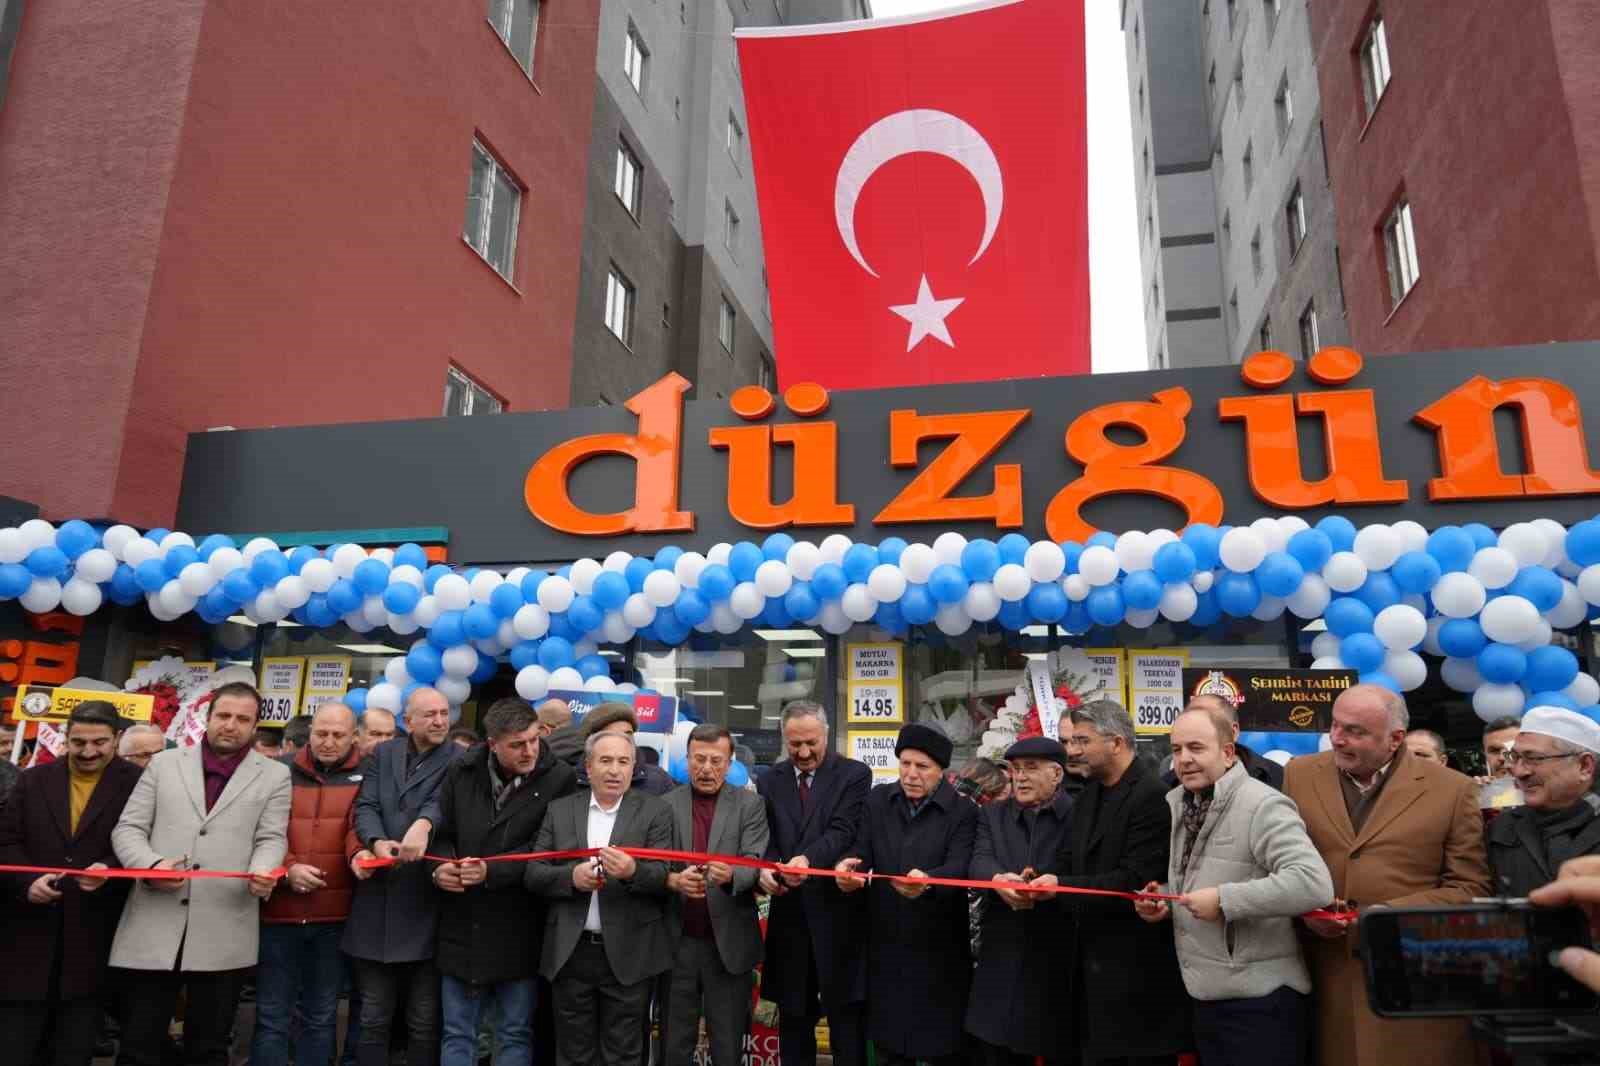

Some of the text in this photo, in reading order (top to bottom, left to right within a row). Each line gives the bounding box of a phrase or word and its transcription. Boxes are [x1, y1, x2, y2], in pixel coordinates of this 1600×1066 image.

[524, 346, 1600, 543] düzgün
[860, 650, 887, 658] MUTLU
[855, 660, 895, 668] MAKARNA
[1251, 675, 1350, 691] ŞEHRİN TARİHİ
[1271, 692, 1332, 703] MARKASI
[854, 699, 893, 717] 14.95
[1138, 705, 1180, 725] 399.00
[857, 737, 896, 752] TAT SALÇA
[877, 755, 888, 766] GR
